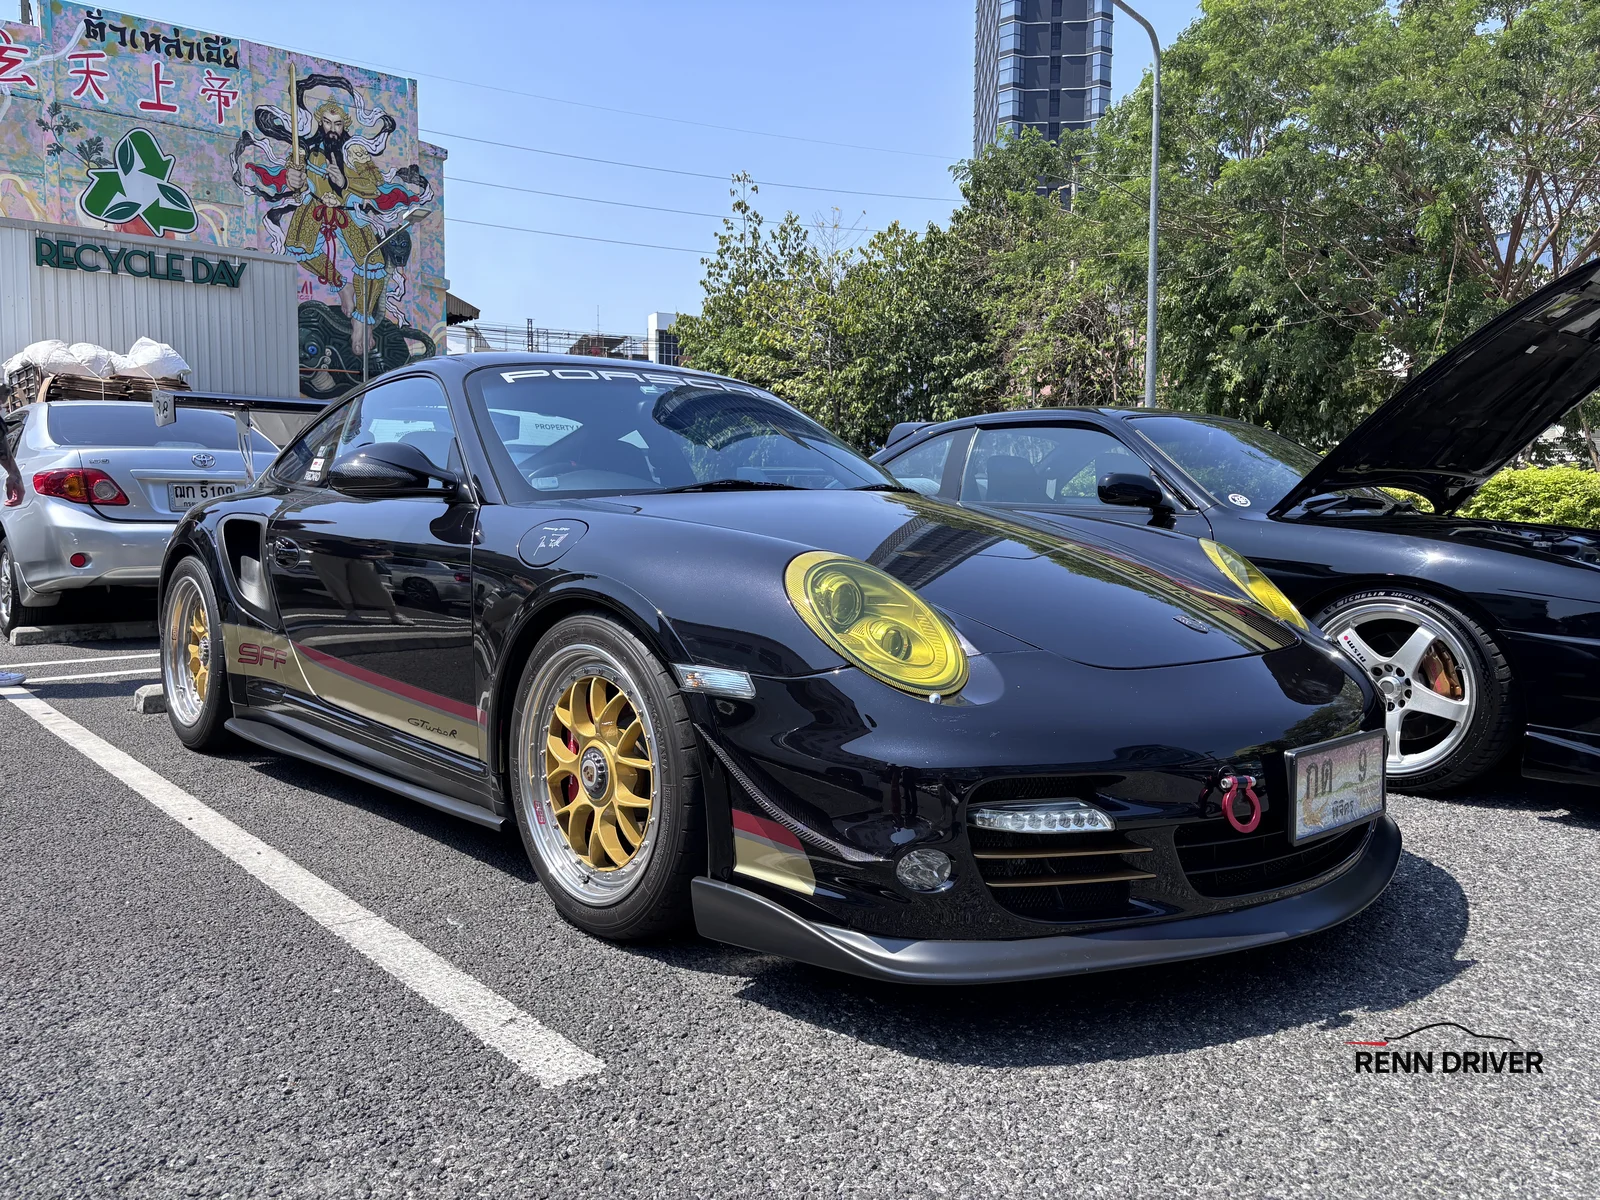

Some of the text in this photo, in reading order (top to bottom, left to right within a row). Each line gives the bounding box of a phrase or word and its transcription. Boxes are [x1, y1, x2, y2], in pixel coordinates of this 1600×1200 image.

[0, 29, 239, 125] 玄天上帝
[35, 237, 247, 288] RECYCLE DAY
[500, 369, 764, 399] PORSCH
[534, 423, 575, 431] PROPERTY
[1336, 591, 1386, 606] MICHELIN
[1358, 748, 1367, 782] 9
